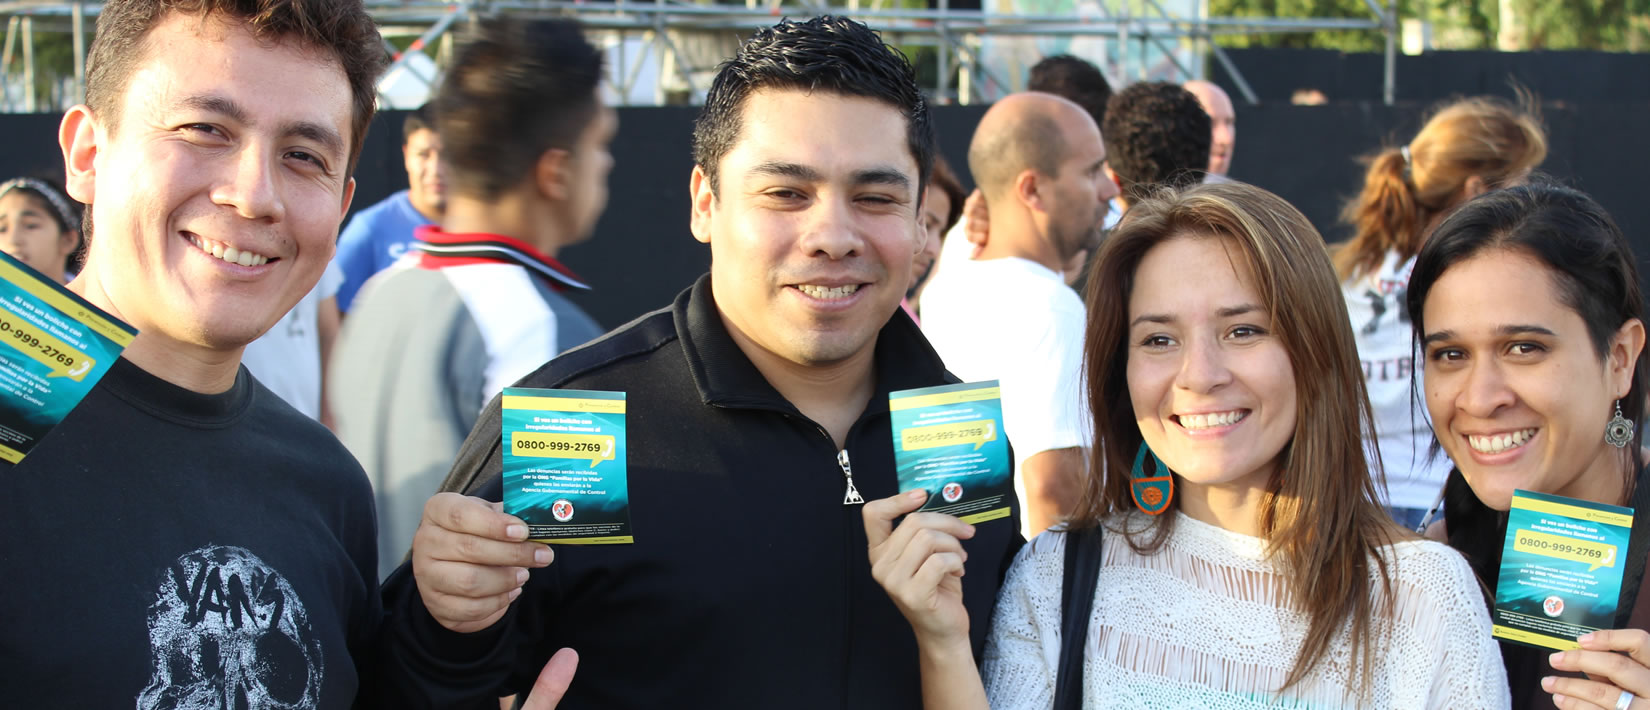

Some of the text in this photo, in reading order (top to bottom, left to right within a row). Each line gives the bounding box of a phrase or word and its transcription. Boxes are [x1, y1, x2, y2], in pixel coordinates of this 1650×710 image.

[22, 301, 35, 311] ves
[34, 308, 45, 316] un
[43, 312, 70, 330] boliche
[68, 328, 82, 338] con
[0, 318, 74, 367] 0-999-2769
[517, 440, 601, 452] 0800-999-2769
[1520, 537, 1602, 559] 0800-999-2769
